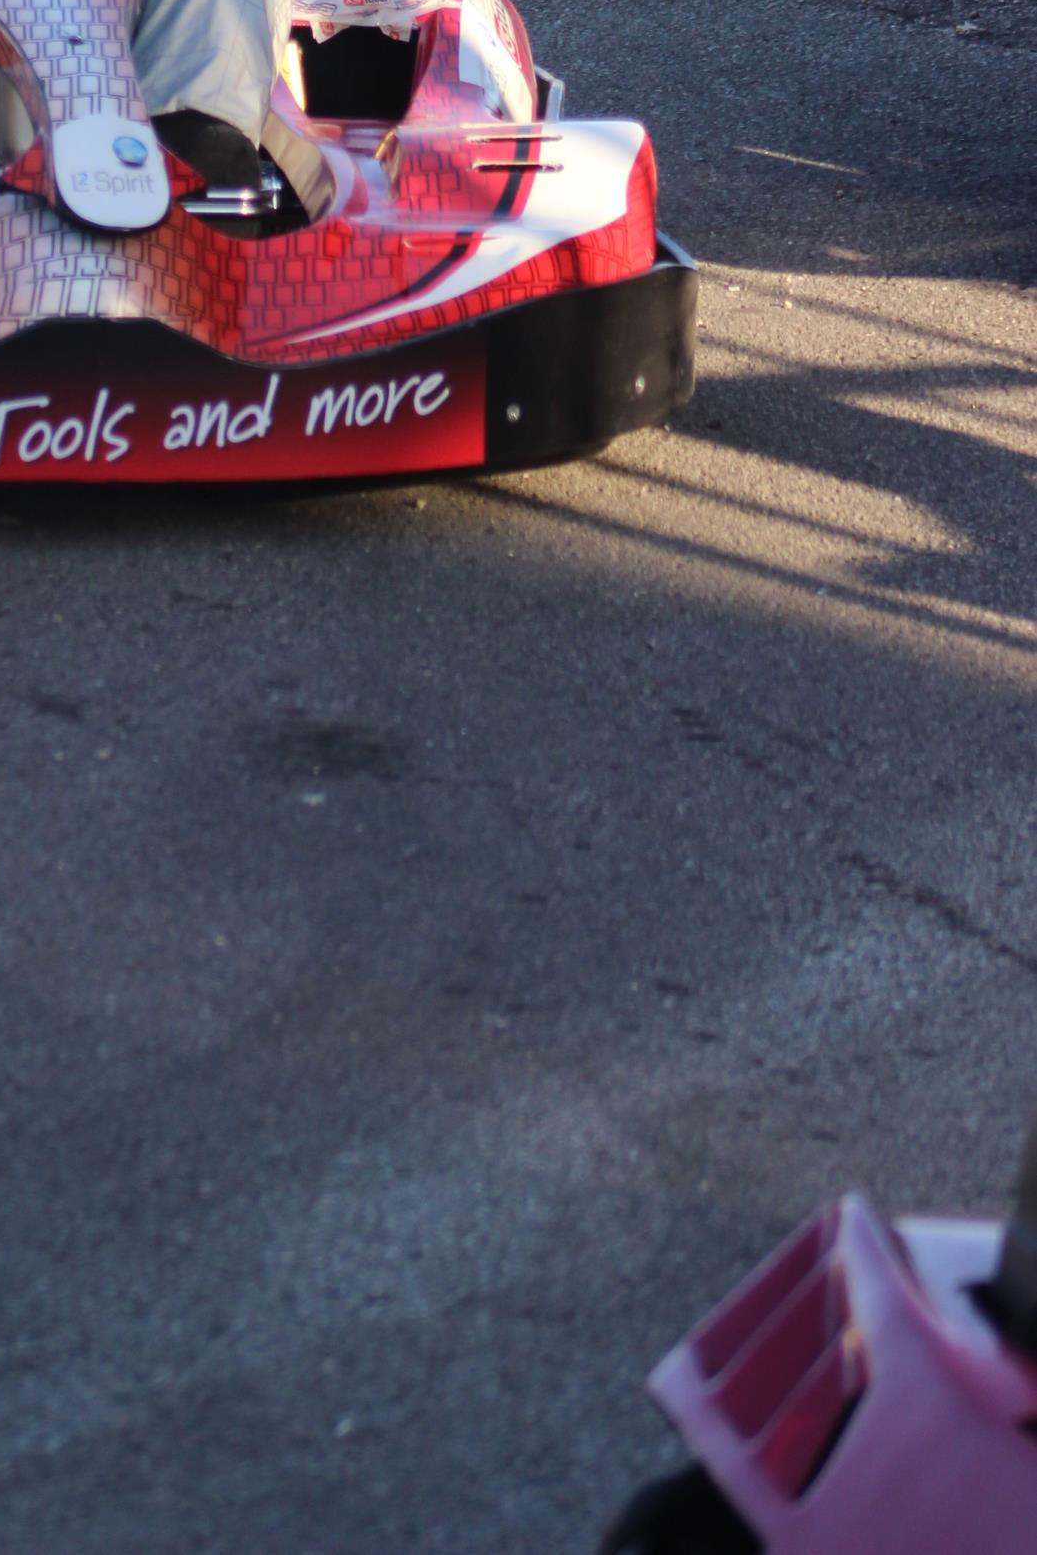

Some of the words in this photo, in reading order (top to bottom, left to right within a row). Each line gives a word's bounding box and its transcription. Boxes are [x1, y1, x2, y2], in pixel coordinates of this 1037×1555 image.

[93, 170, 156, 196] Spirit
[162, 371, 281, 451] and
[304, 370, 451, 436] more
